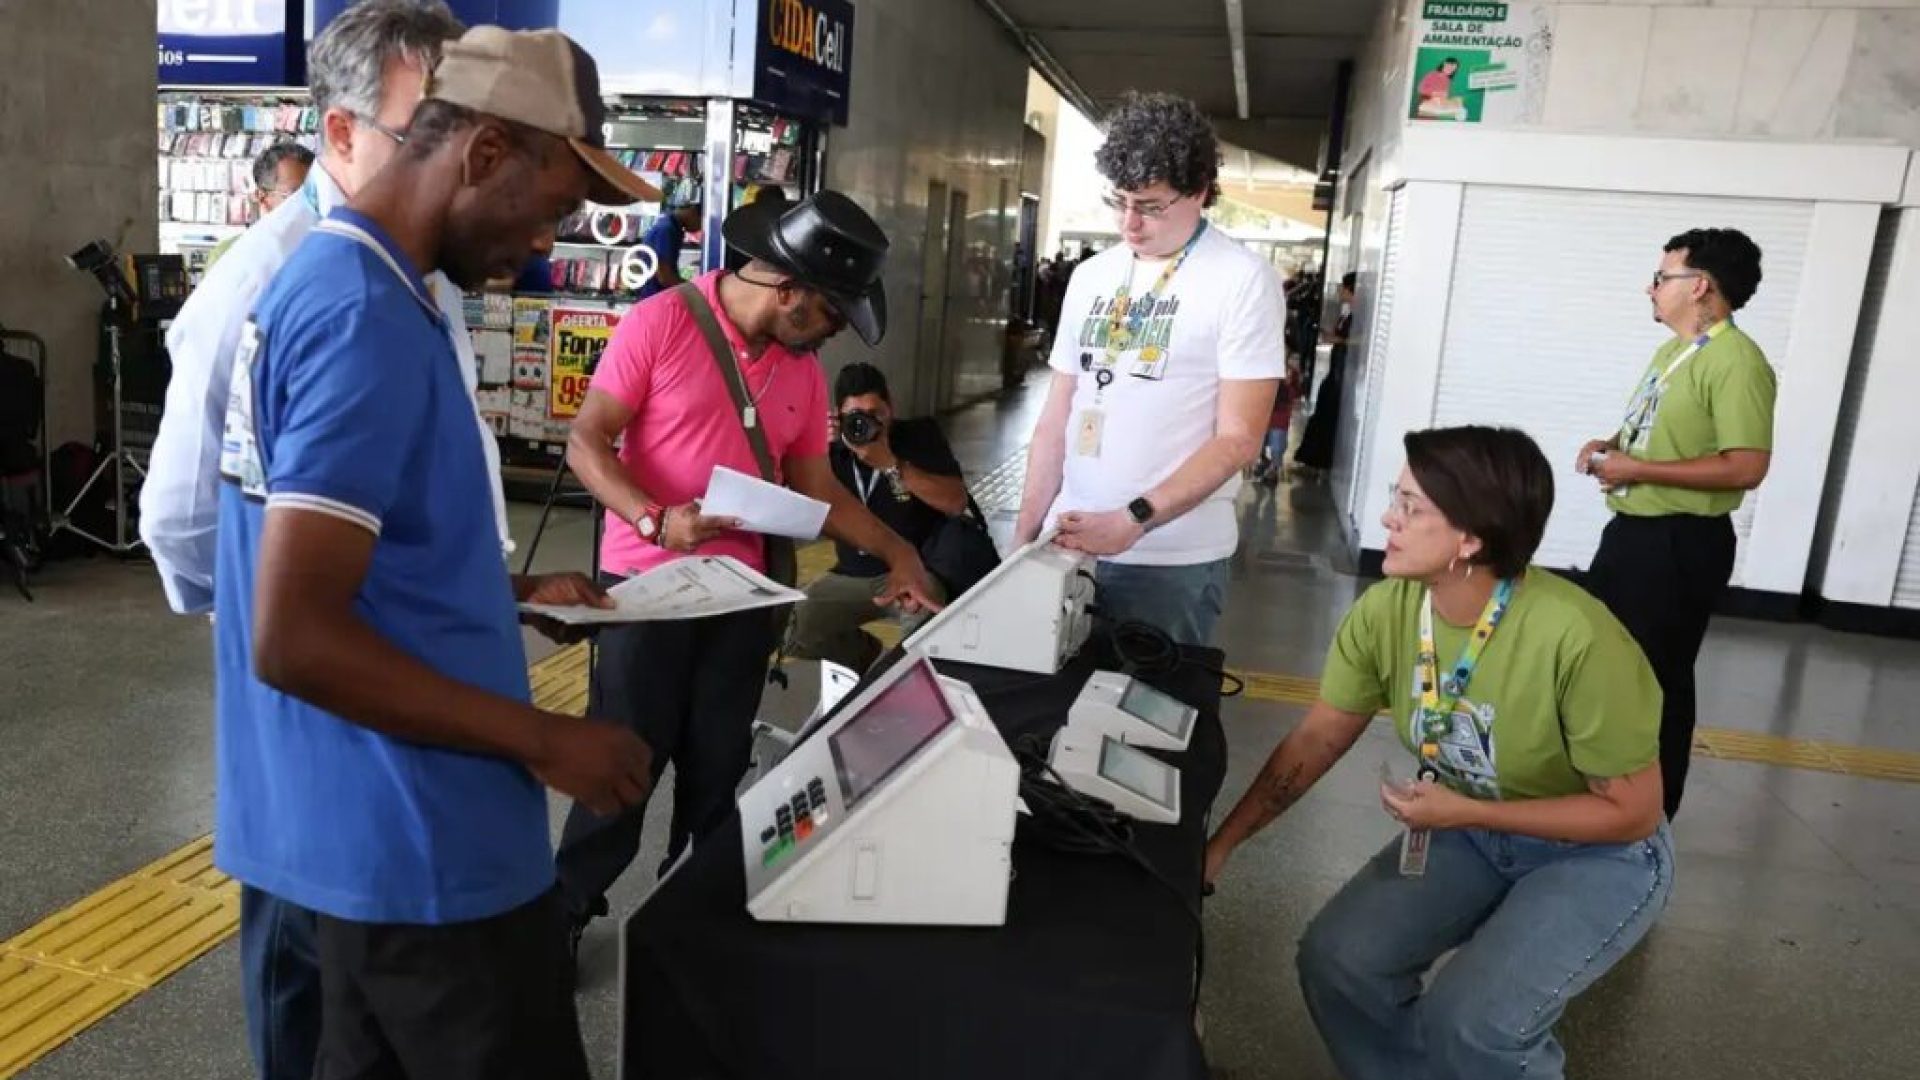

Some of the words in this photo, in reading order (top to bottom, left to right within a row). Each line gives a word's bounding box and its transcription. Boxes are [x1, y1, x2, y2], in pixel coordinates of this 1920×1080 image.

[157, 0, 259, 30] ell
[1428, 4, 1494, 17] FRALDÁRIO
[1498, 7, 1505, 17] E
[1432, 21, 1463, 31] SALA
[1468, 23, 1484, 32] DE
[769, 0, 844, 72] CIDACell
[1422, 33, 1522, 48] AMAMENTAÇÃO
[562, 314, 606, 327] OFERTA
